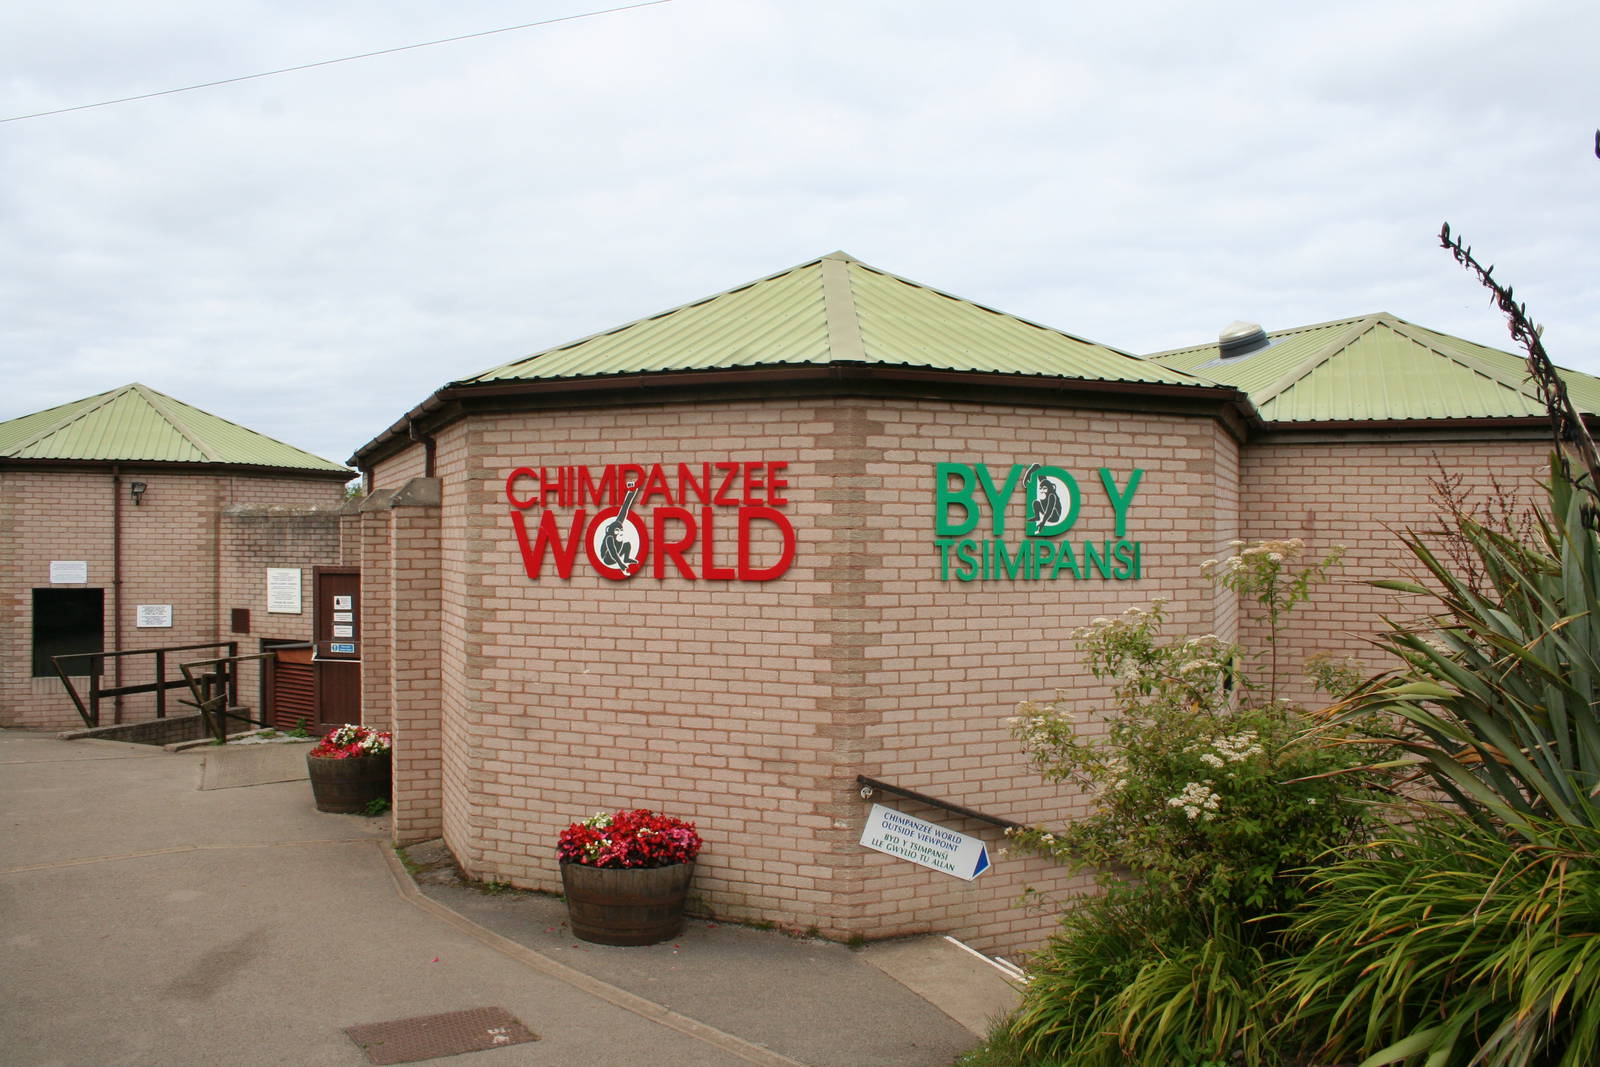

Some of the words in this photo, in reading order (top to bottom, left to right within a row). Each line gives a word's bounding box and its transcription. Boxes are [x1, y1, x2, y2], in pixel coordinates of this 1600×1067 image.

[505, 460, 789, 510] CHIMPANZEE
[510, 506, 796, 581] WORLD
[935, 538, 1141, 581] TSIMPANSI
[881, 820, 915, 838] OUTSIDE
[917, 832, 960, 852] VIEWPOINT
[883, 812, 932, 834] CHIMPANZEE
[934, 829, 962, 844] WORLD
[883, 833, 900, 844] BYD
[871, 838, 885, 848] LLE
[886, 843, 917, 859] GWYLIO
[919, 854, 930, 863] TU
[932, 858, 955, 871] ALLAN
